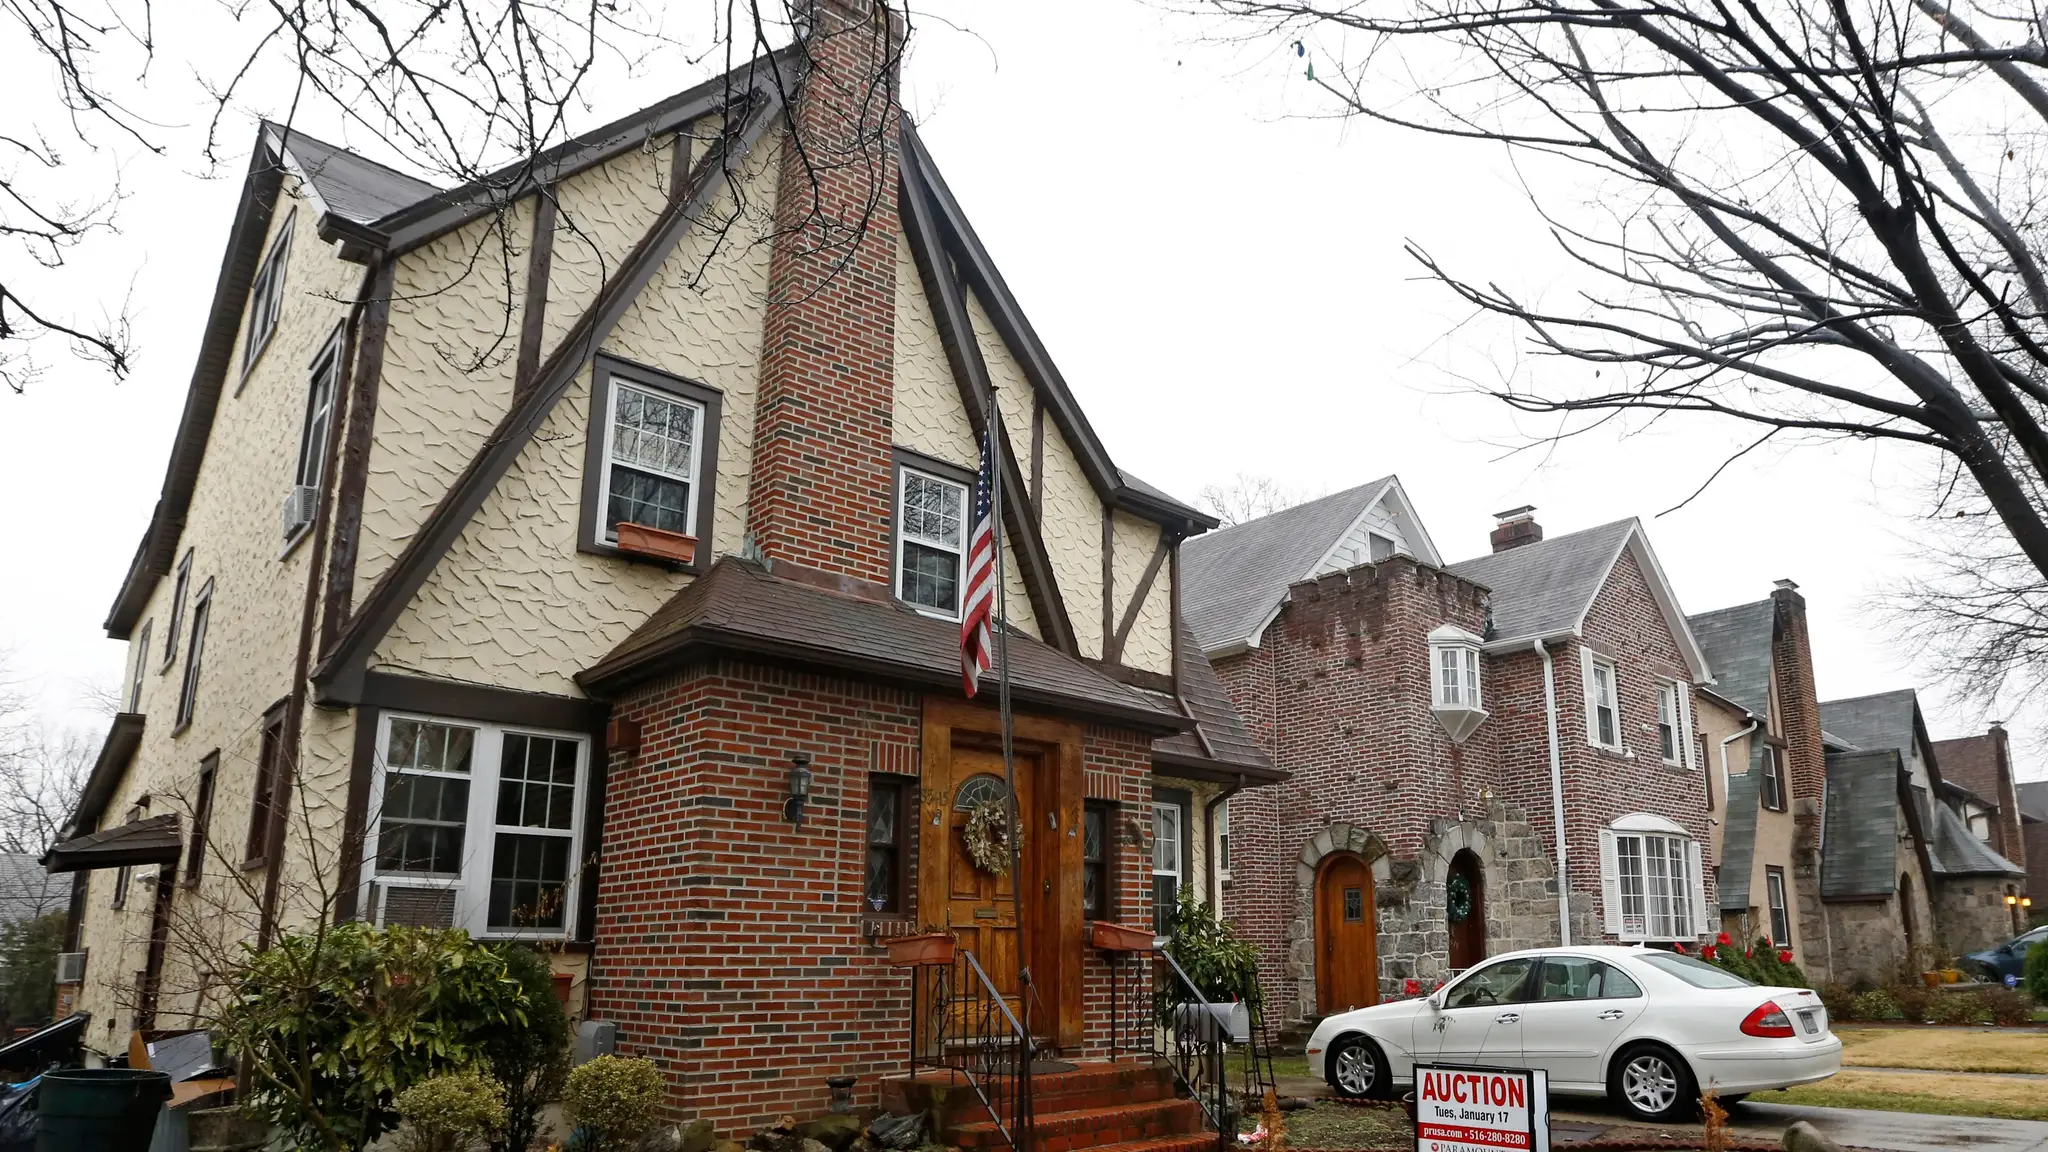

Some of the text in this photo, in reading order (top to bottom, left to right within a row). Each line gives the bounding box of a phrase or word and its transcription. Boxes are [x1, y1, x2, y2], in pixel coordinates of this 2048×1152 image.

[1422, 1072, 1524, 1108] AUCTION
[1434, 1106, 1509, 1124] Tues, January 17
[1423, 1127, 1526, 1145] prusa.com 516-280-8280
[1440, 1143, 1508, 1152] PARAMO
